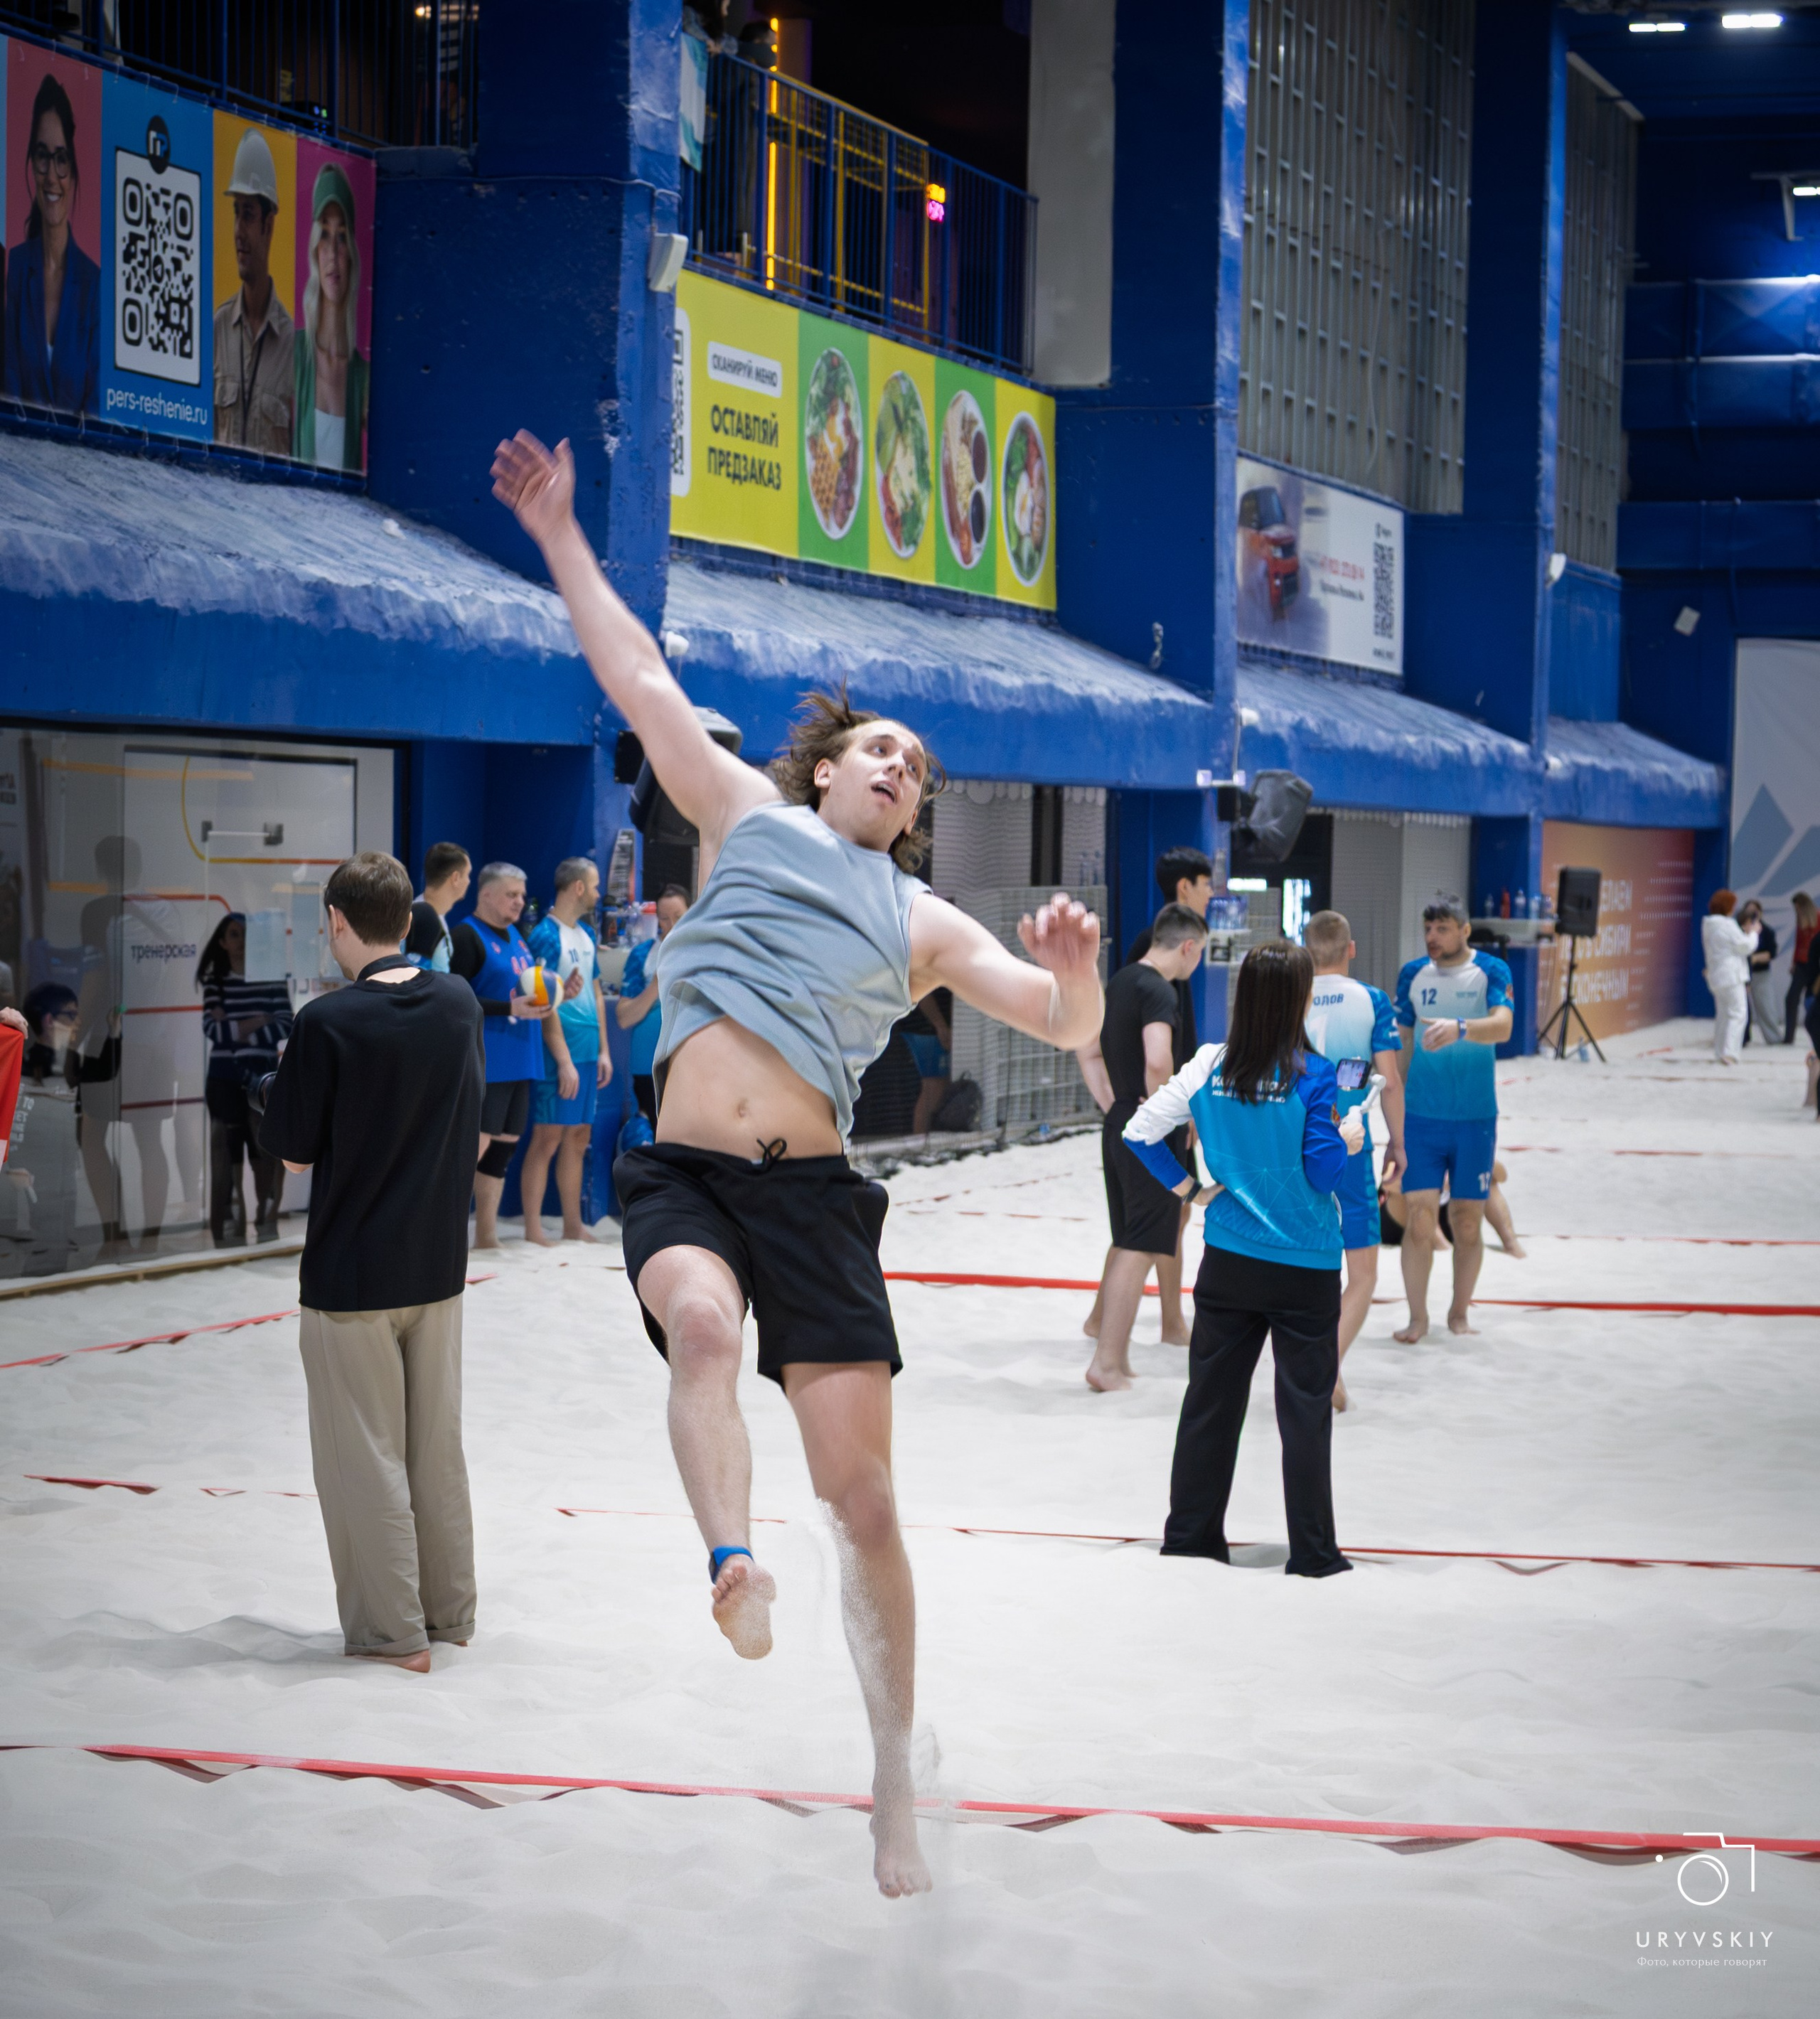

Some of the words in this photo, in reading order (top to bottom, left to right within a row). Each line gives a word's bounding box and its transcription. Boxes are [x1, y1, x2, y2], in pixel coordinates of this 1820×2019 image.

[712, 354, 753, 380] СКАНИРУЙ
[755, 365, 778, 387] МЕНЮ
[107, 388, 208, 425] pers-reshenie.ru
[712, 404, 778, 448] ОСТАВЛЯЙ
[708, 446, 781, 491] ПРЕДЗАКАЗ
[131, 941, 196, 964] тренерская
[1313, 993, 1344, 1006] ОЛОВ
[1422, 987, 1438, 1006] 12
